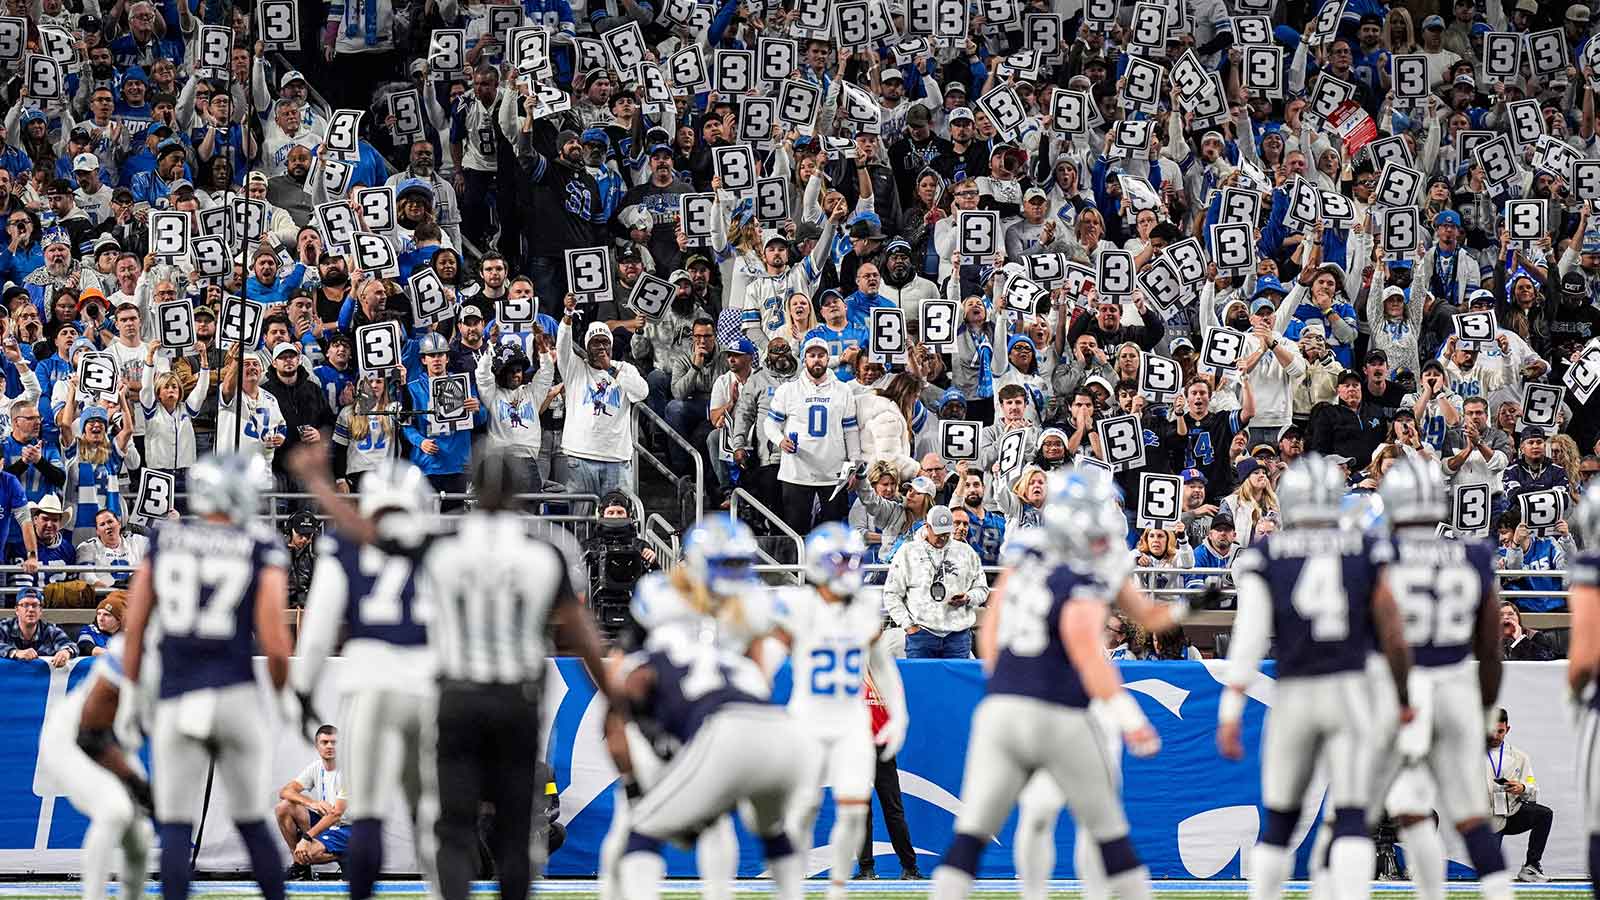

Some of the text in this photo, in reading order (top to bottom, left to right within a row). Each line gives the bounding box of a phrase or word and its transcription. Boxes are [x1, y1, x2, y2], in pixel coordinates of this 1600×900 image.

[267, 4, 292, 38] 3
[496, 10, 517, 41] 3
[801, 0, 825, 27] 3
[847, 7, 866, 44] 3
[912, 2, 933, 31] 3
[940, 2, 963, 36] 3
[1140, 9, 1161, 45] 3
[1240, 19, 1264, 42] 3
[1317, 3, 1338, 31] 3
[0, 20, 20, 58] 3
[50, 32, 72, 61] 3
[205, 30, 229, 66] 3
[440, 34, 459, 69] 3
[520, 37, 543, 68] 3
[612, 30, 639, 67] 3
[1034, 20, 1057, 53] 3
[582, 41, 604, 68] 3
[676, 53, 700, 86] 3
[766, 44, 791, 79] 3
[1252, 51, 1276, 87] 3
[1492, 37, 1516, 73] 3
[1537, 36, 1562, 72] 3
[32, 60, 56, 95] 3
[647, 68, 667, 101] 3
[722, 55, 747, 91] 3
[1130, 65, 1153, 100] 3
[1178, 60, 1203, 96] 3
[1401, 60, 1424, 95] 3
[396, 96, 418, 130] 3
[786, 87, 812, 123] 3
[988, 97, 1014, 130] 3
[1057, 95, 1080, 130] 3
[1318, 82, 1346, 117] 3
[330, 116, 353, 150] 3
[747, 103, 769, 138] 3
[1120, 121, 1148, 146] 3
[1517, 105, 1541, 140] 3
[325, 160, 347, 194] 3
[721, 151, 747, 188] 3
[1484, 145, 1509, 177] 3
[1386, 170, 1413, 204] 3
[1579, 164, 1600, 198] 3
[364, 192, 389, 225] 3
[689, 198, 711, 233] 3
[761, 182, 785, 217] 3
[1228, 195, 1252, 222] 3
[1298, 190, 1317, 220] 3
[1323, 193, 1347, 216] 3
[157, 217, 183, 251] 3
[237, 204, 260, 238] 3
[327, 208, 352, 242] 3
[966, 217, 992, 251] 3
[1390, 212, 1413, 247] 3
[1514, 205, 1541, 237] 3
[200, 239, 225, 273] 3
[361, 236, 388, 268] 3
[1178, 246, 1203, 276] 3
[1222, 227, 1246, 264] 3
[576, 254, 603, 290] 3
[1034, 254, 1058, 277] 3
[1106, 258, 1129, 292] 3
[418, 276, 443, 312] 3
[638, 284, 666, 315] 3
[1009, 282, 1032, 310] 3
[1147, 273, 1176, 305] 3
[165, 306, 189, 342] 3
[229, 303, 255, 339] 3
[878, 313, 901, 350] 3
[927, 305, 952, 340] 3
[1463, 315, 1489, 337] 3
[366, 329, 392, 365] 3
[1210, 332, 1238, 363] 3
[85, 363, 113, 390] 3
[1148, 358, 1176, 387] 3
[806, 397, 830, 405] DETROIT
[1527, 388, 1555, 423] 3
[808, 405, 828, 437] 0
[948, 425, 974, 457] 3
[1002, 432, 1022, 472] 3
[1109, 421, 1136, 458] 3
[144, 478, 169, 515] 3
[1147, 479, 1176, 517] 3
[1462, 490, 1485, 527] 3
[1530, 493, 1556, 526] 3
[154, 551, 255, 640] 87
[1293, 553, 1349, 642] 4
[810, 648, 862, 695] 29
